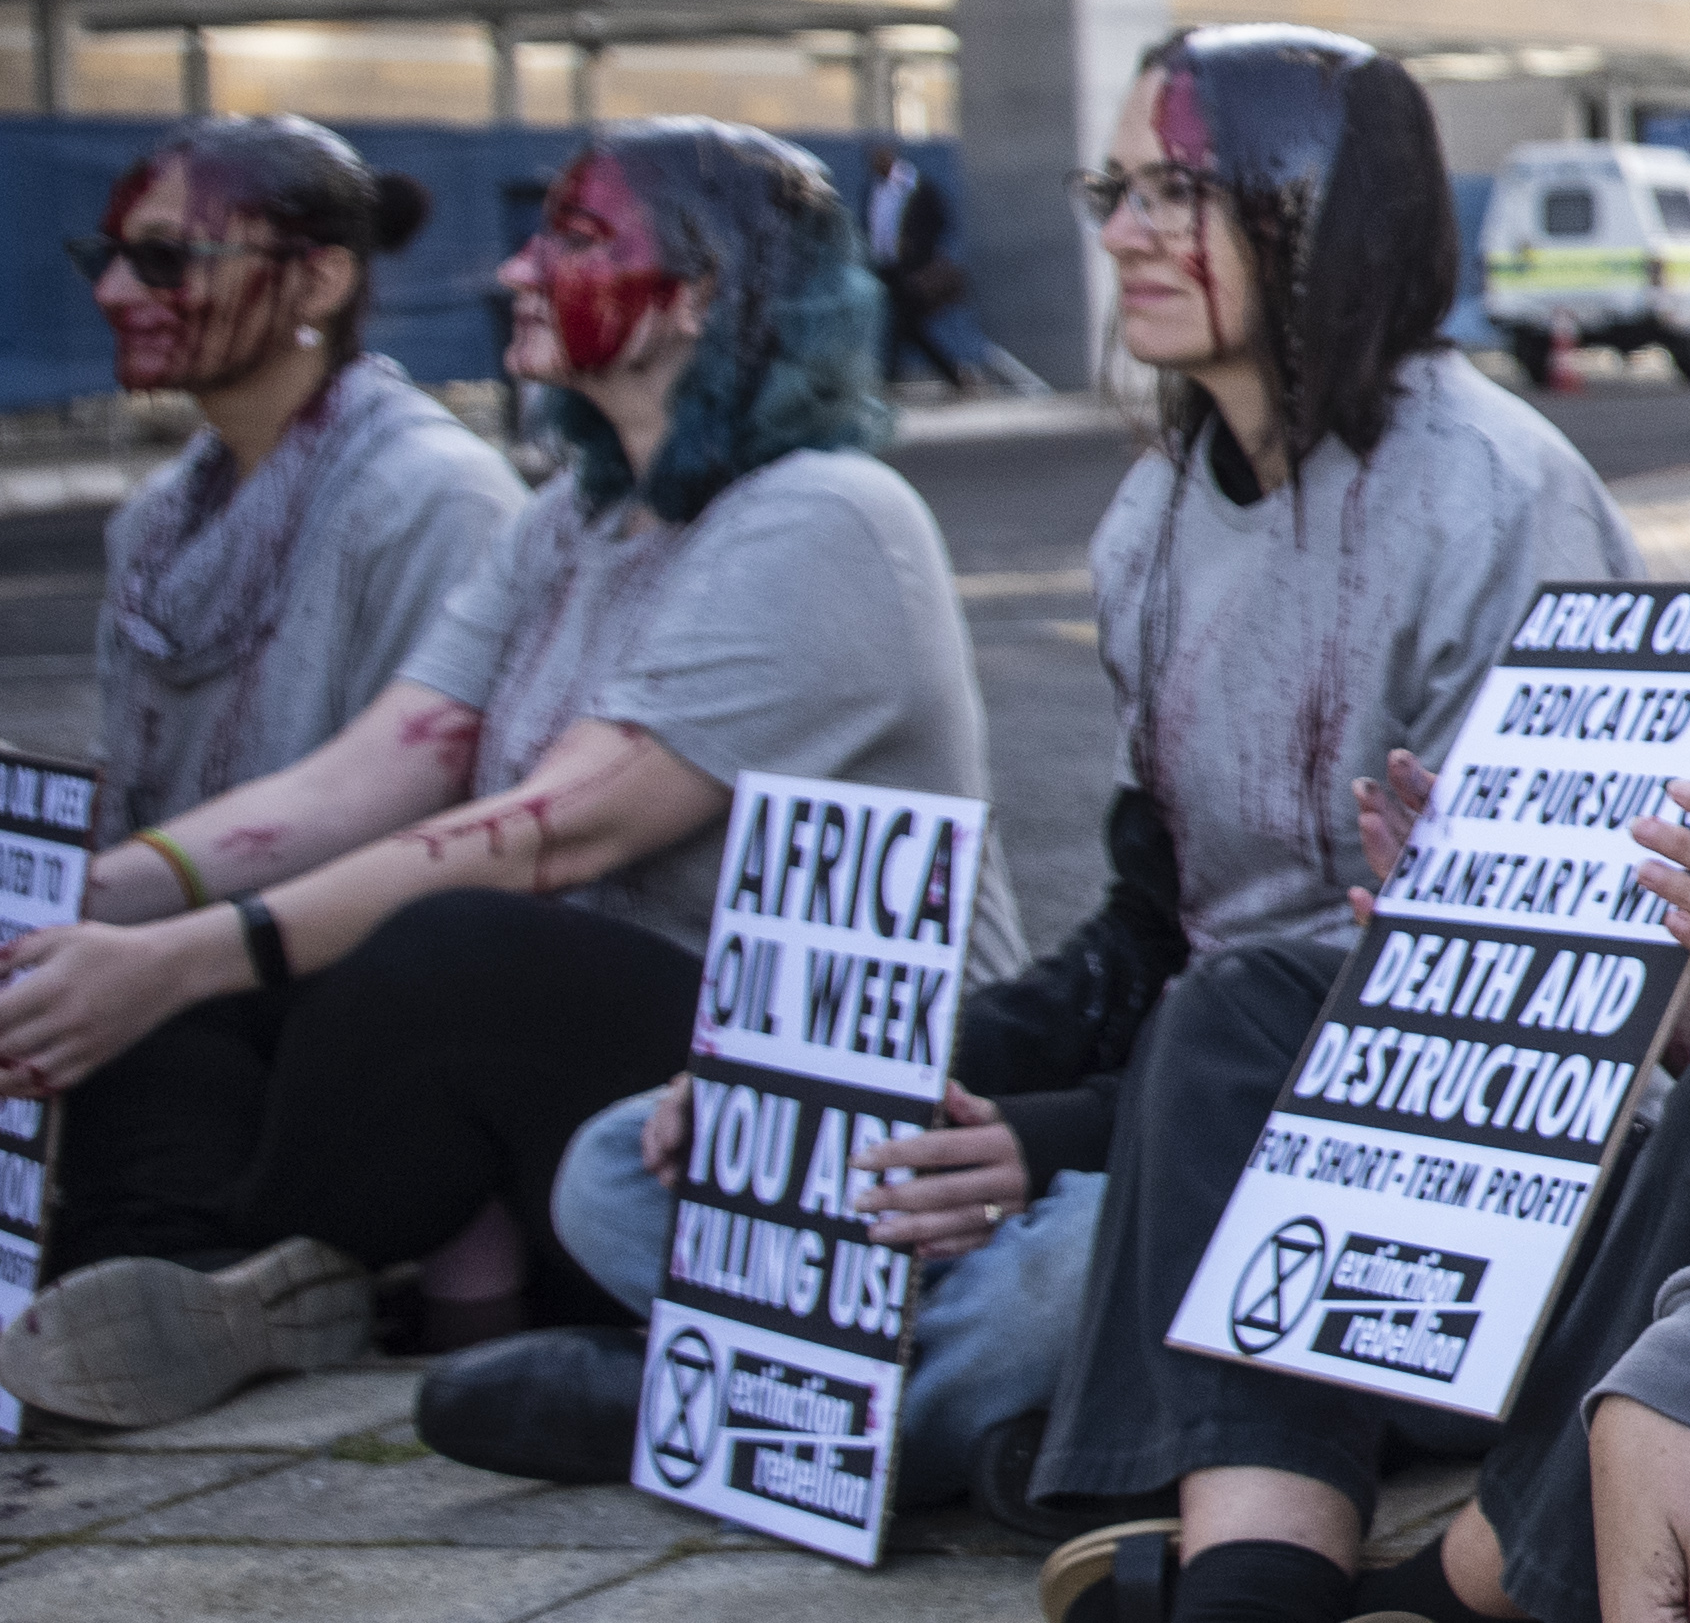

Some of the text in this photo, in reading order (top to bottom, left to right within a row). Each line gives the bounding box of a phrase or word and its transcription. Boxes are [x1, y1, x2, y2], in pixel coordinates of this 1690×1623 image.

[1512, 593, 1655, 653] AFRICA
[1446, 764, 1520, 820] THE
[724, 791, 954, 946] AFRICA
[711, 931, 949, 1066] OIL WEEK
[1359, 930, 1646, 1037] DEATH AND
[1294, 1021, 1635, 1144] DESTRUCTION
[687, 1080, 801, 1206] YOU
[1247, 1127, 1588, 1227] FOR SHORT-TERM PROFIT
[669, 1198, 911, 1340] KILLING US!
[1333, 1244, 1465, 1303] extinction
[1340, 1308, 1465, 1375] rebellion
